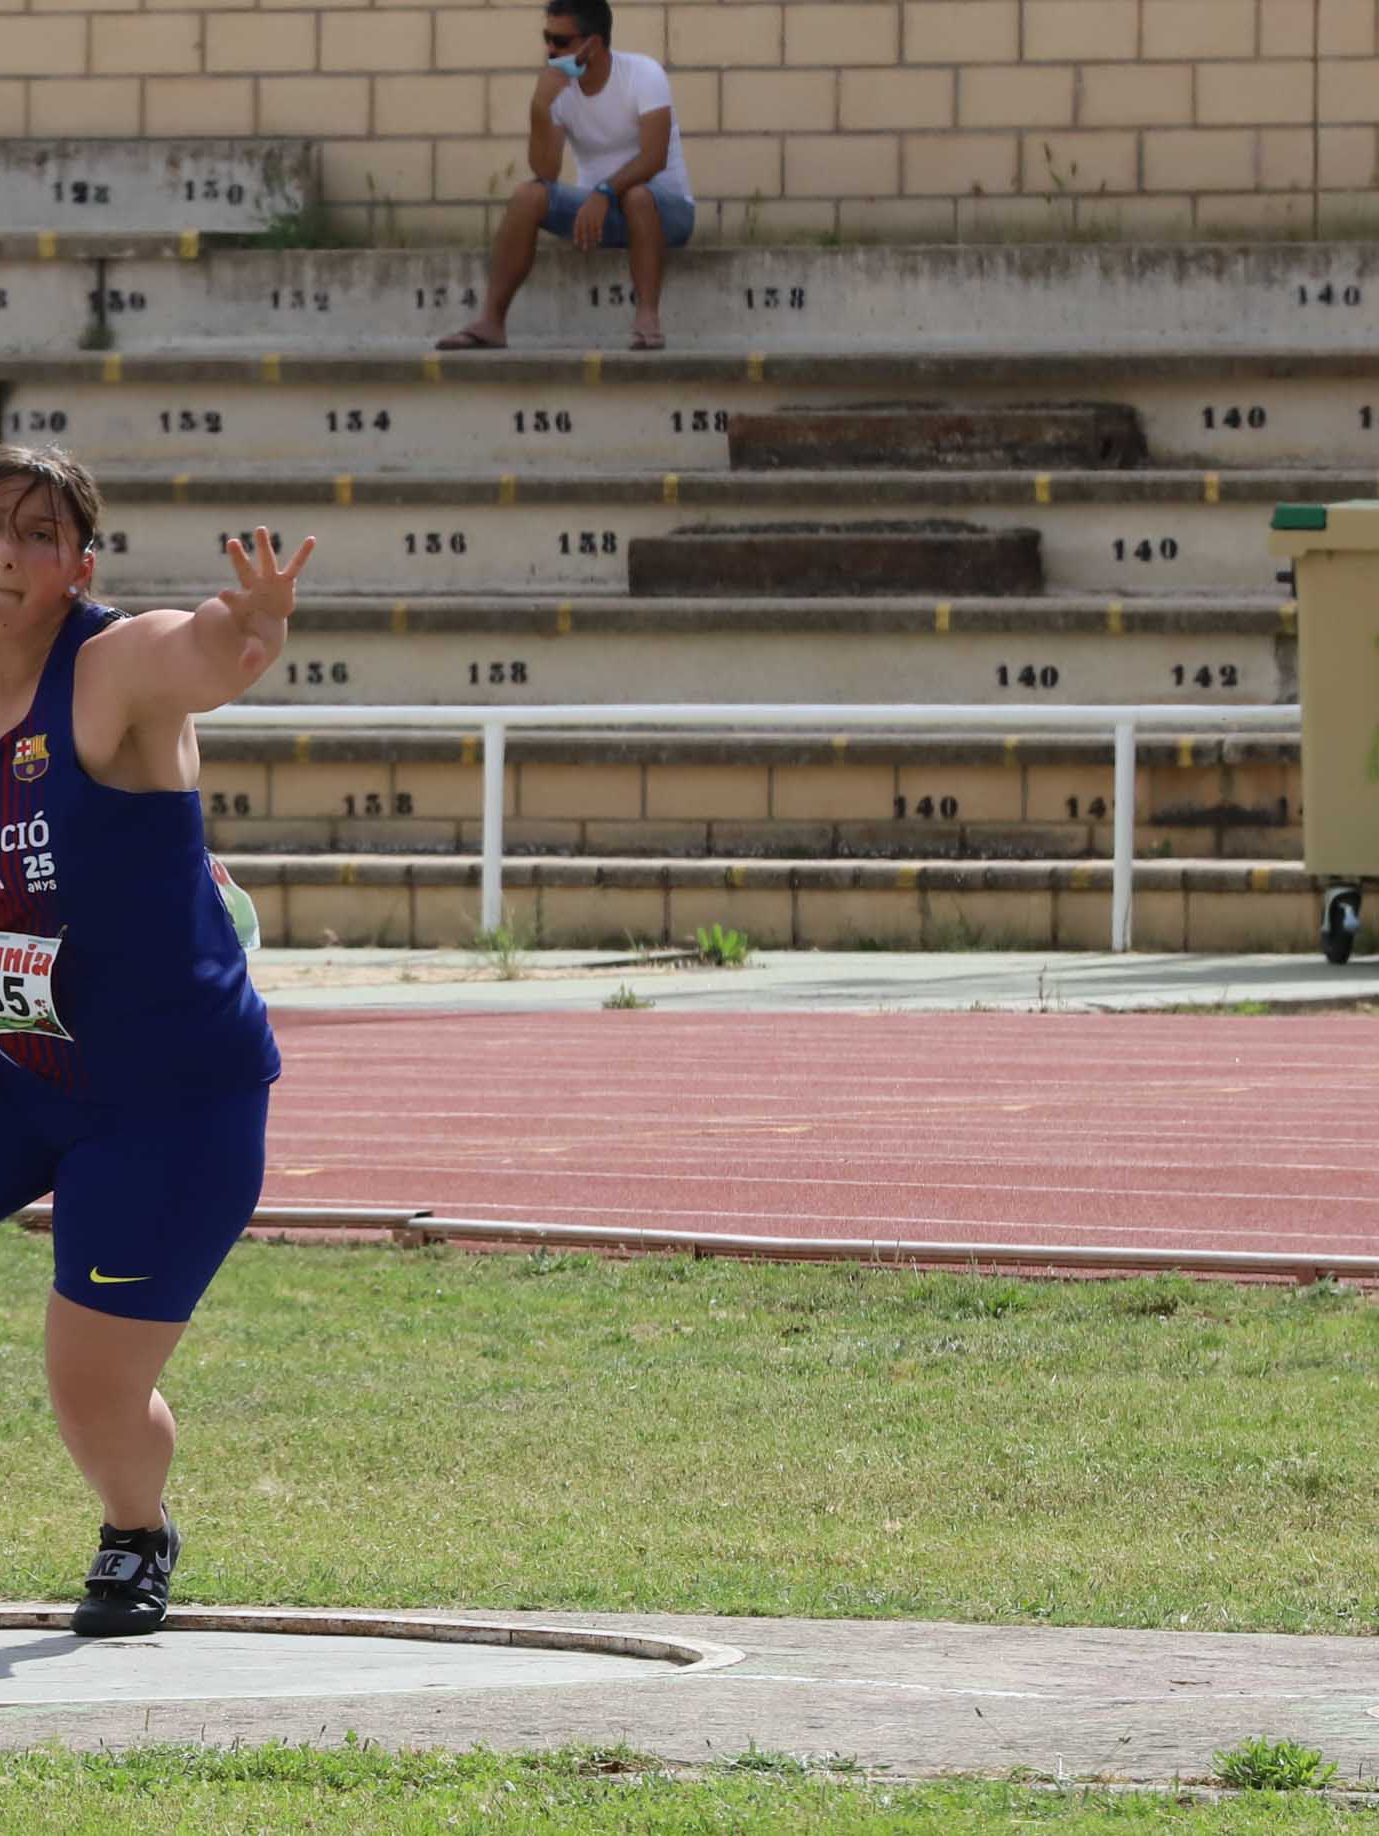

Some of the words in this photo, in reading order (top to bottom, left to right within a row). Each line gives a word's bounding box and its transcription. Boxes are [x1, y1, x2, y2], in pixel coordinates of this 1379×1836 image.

[54, 181, 110, 205] 128
[1298, 285, 1361, 308] 140
[1202, 405, 1266, 430] 140
[1112, 538, 1178, 561] 140
[996, 664, 1059, 688] 140
[1171, 664, 1237, 687] 142
[895, 795, 958, 818] 140
[23, 852, 56, 879] 25
